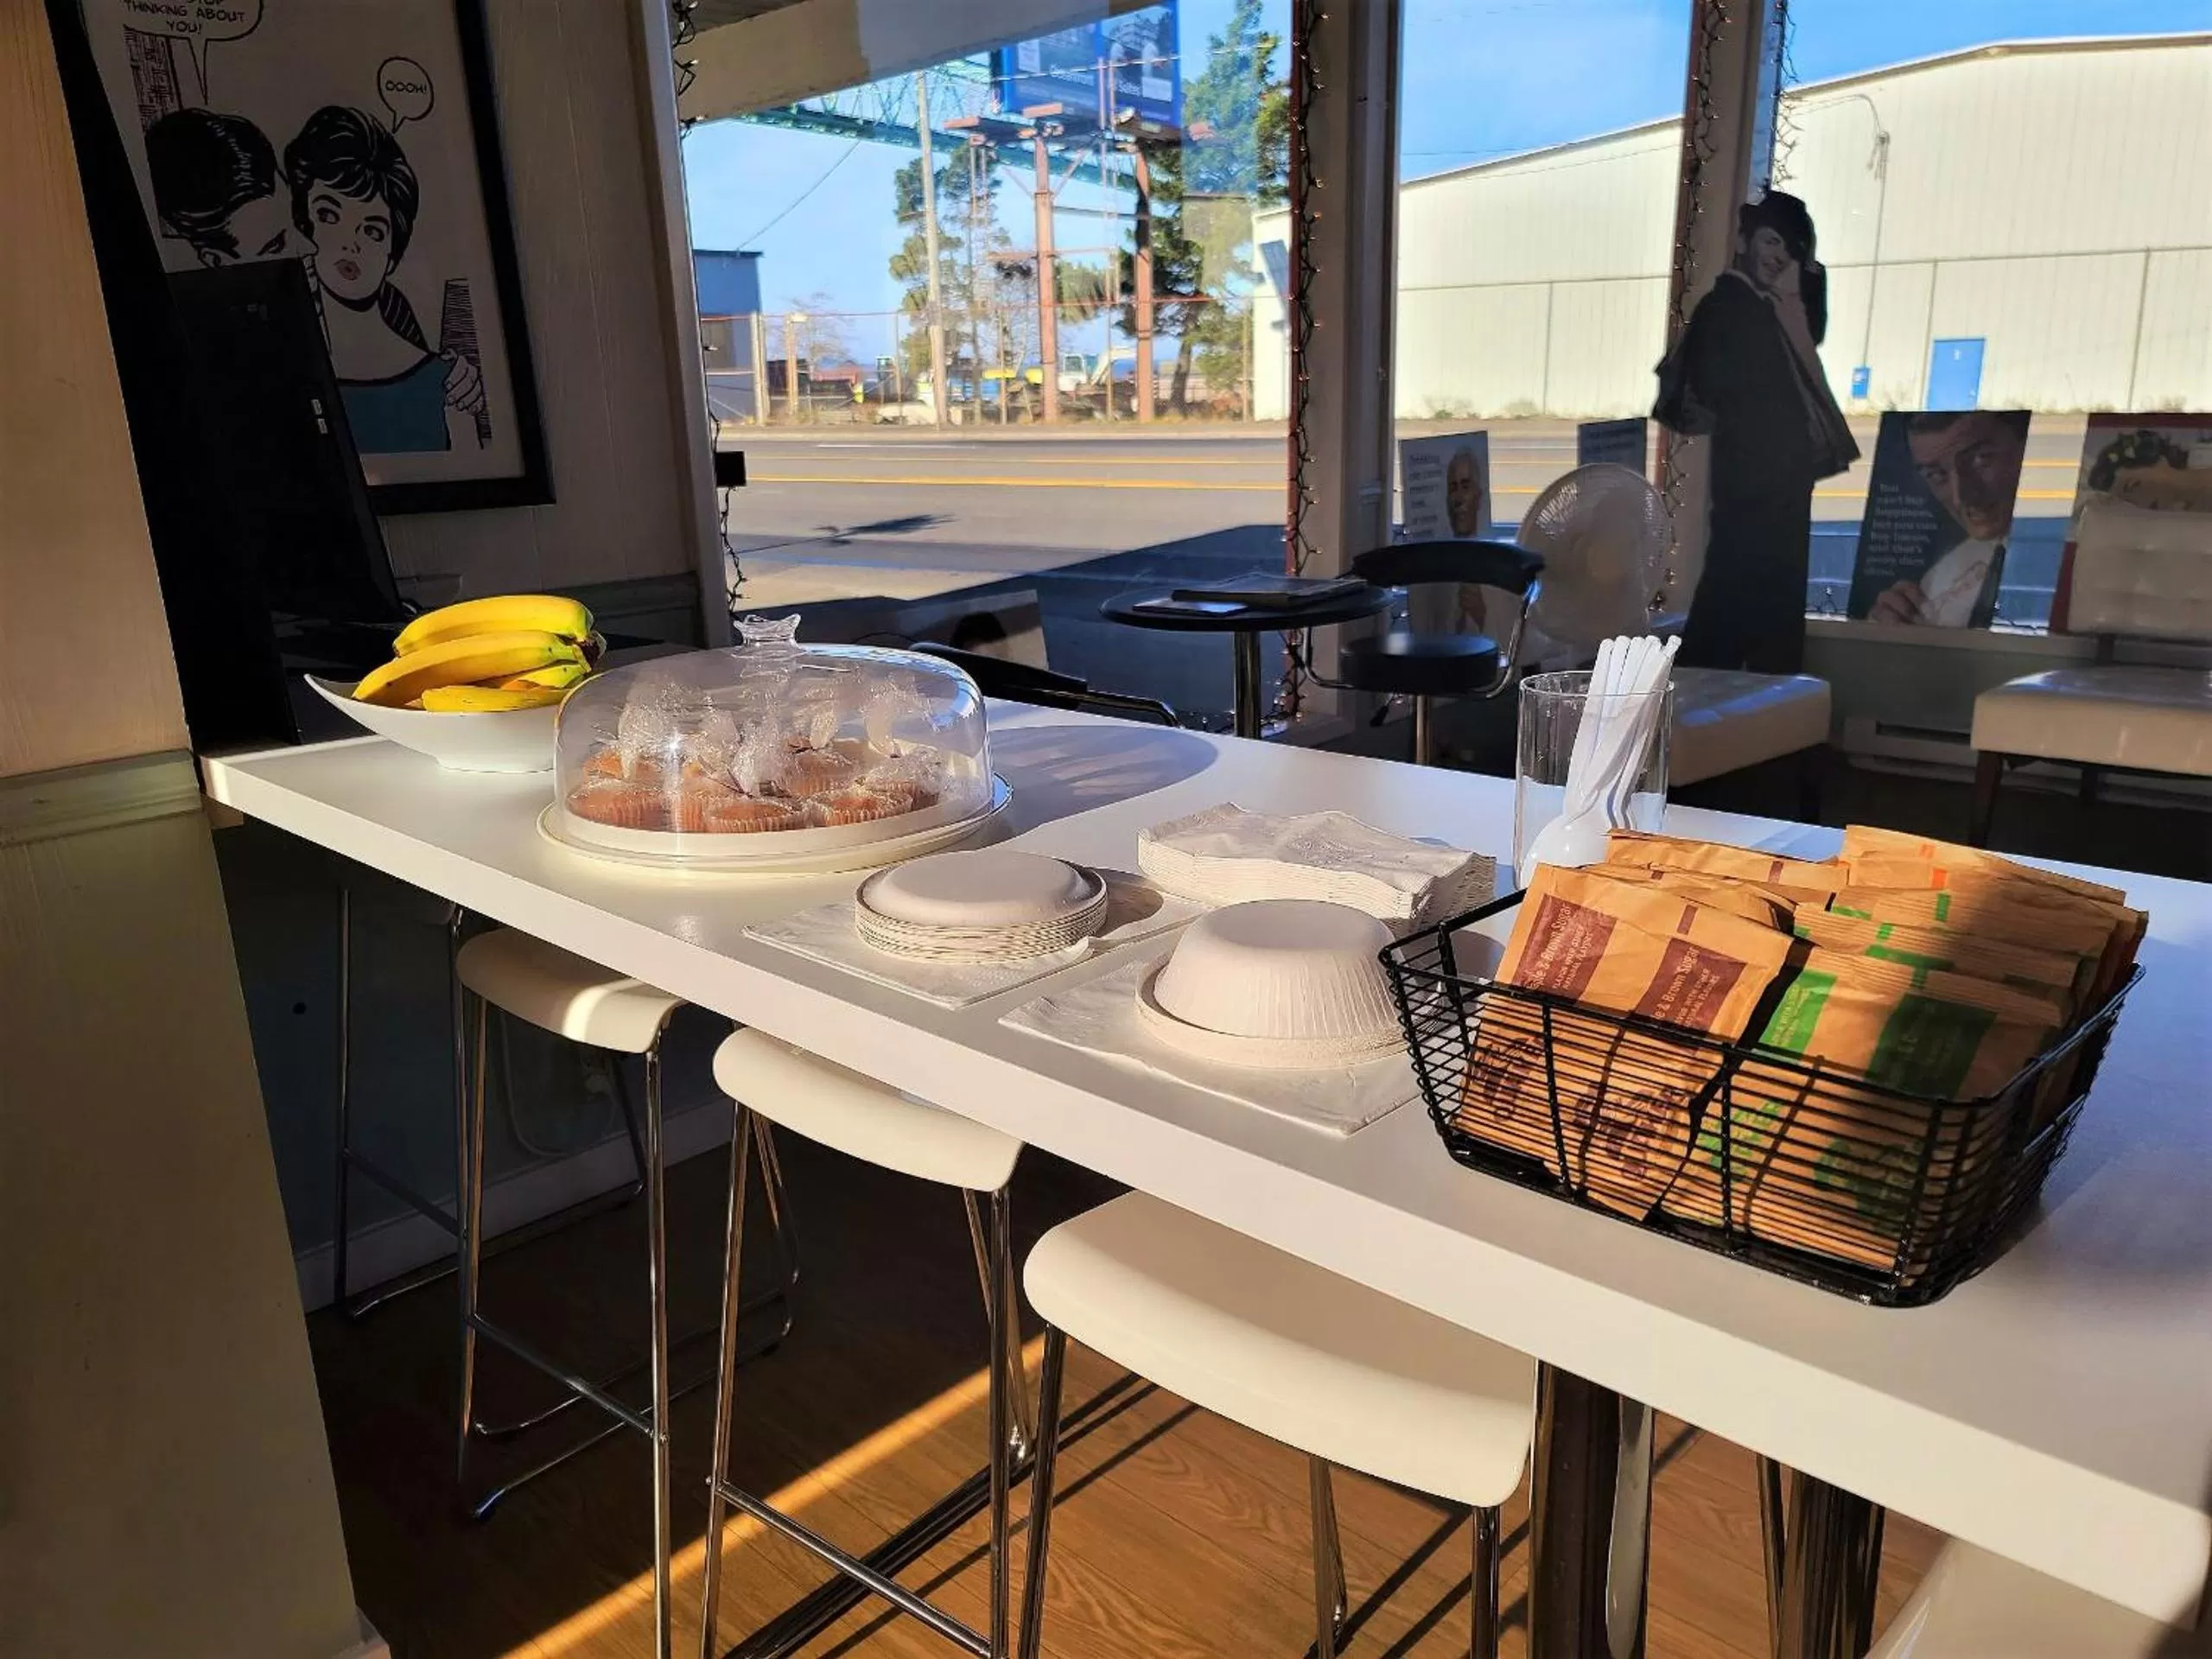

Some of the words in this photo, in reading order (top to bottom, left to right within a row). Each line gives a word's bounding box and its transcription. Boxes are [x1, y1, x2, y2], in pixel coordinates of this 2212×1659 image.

[124, 0, 188, 16] THINKING
[196, 8, 245, 22] ABOUT
[167, 21, 201, 34] YOU!
[385, 80, 427, 94] OOOH!
[1551, 902, 1572, 931] Sugar
[1541, 931, 1565, 961] Brown
[1661, 973, 1688, 1002] Brown
[1675, 947, 1700, 974] Sugar
